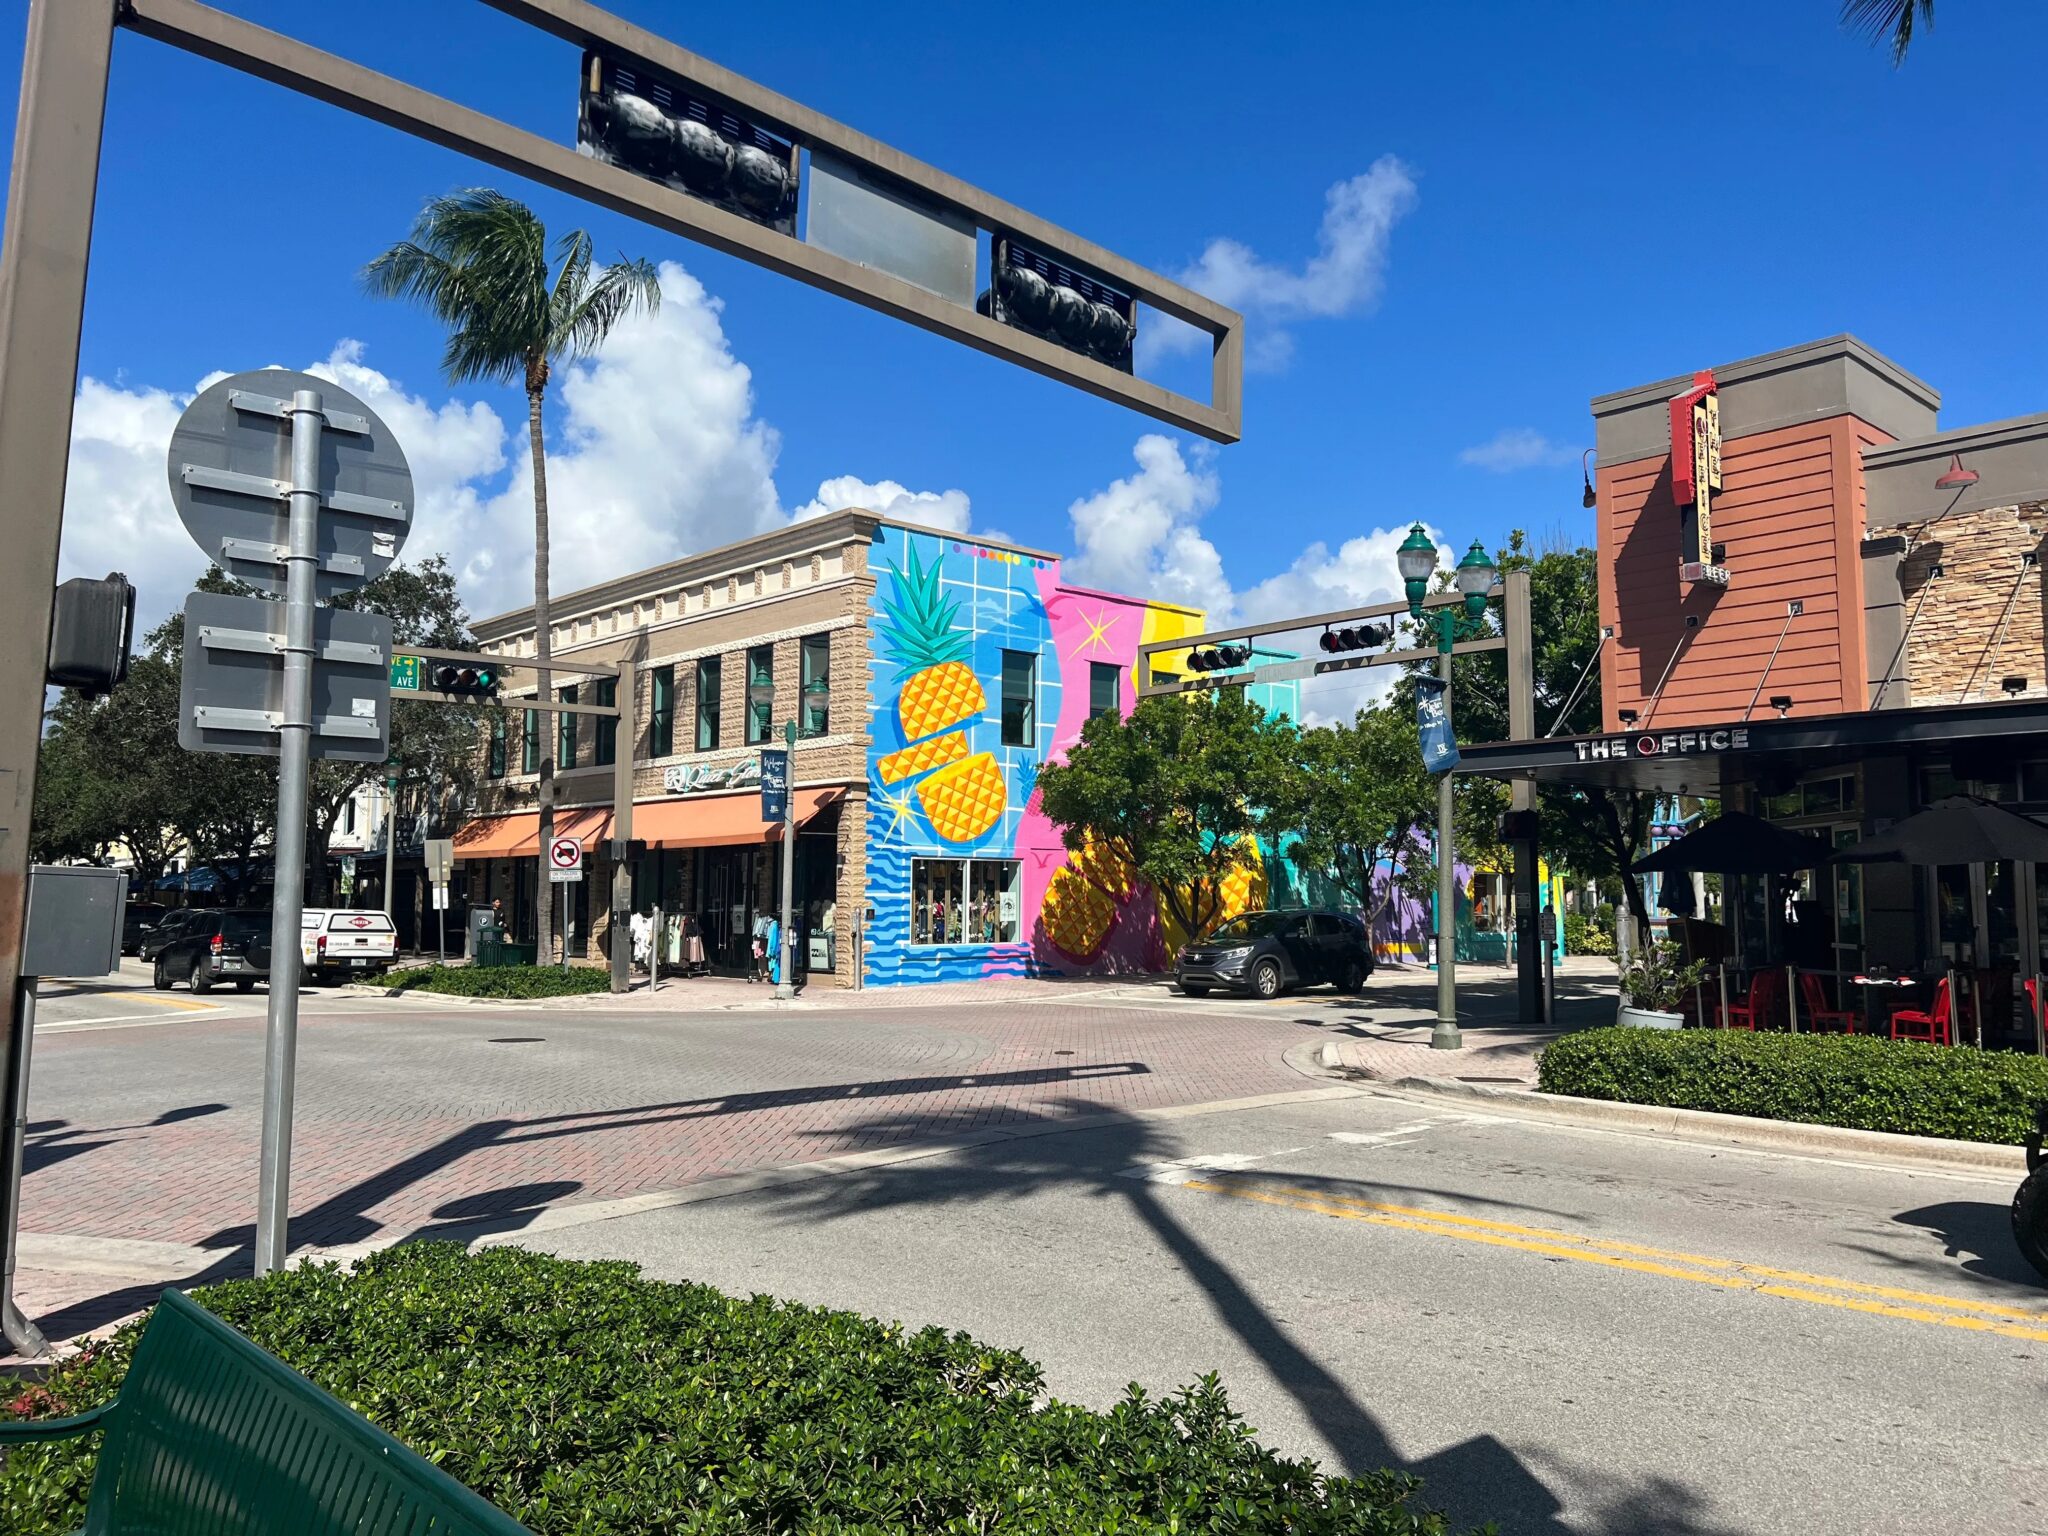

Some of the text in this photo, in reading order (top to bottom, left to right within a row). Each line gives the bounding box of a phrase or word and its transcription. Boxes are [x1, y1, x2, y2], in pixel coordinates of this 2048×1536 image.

[397, 676, 413, 687] AVE
[1574, 728, 1749, 761] THE OFFICE
